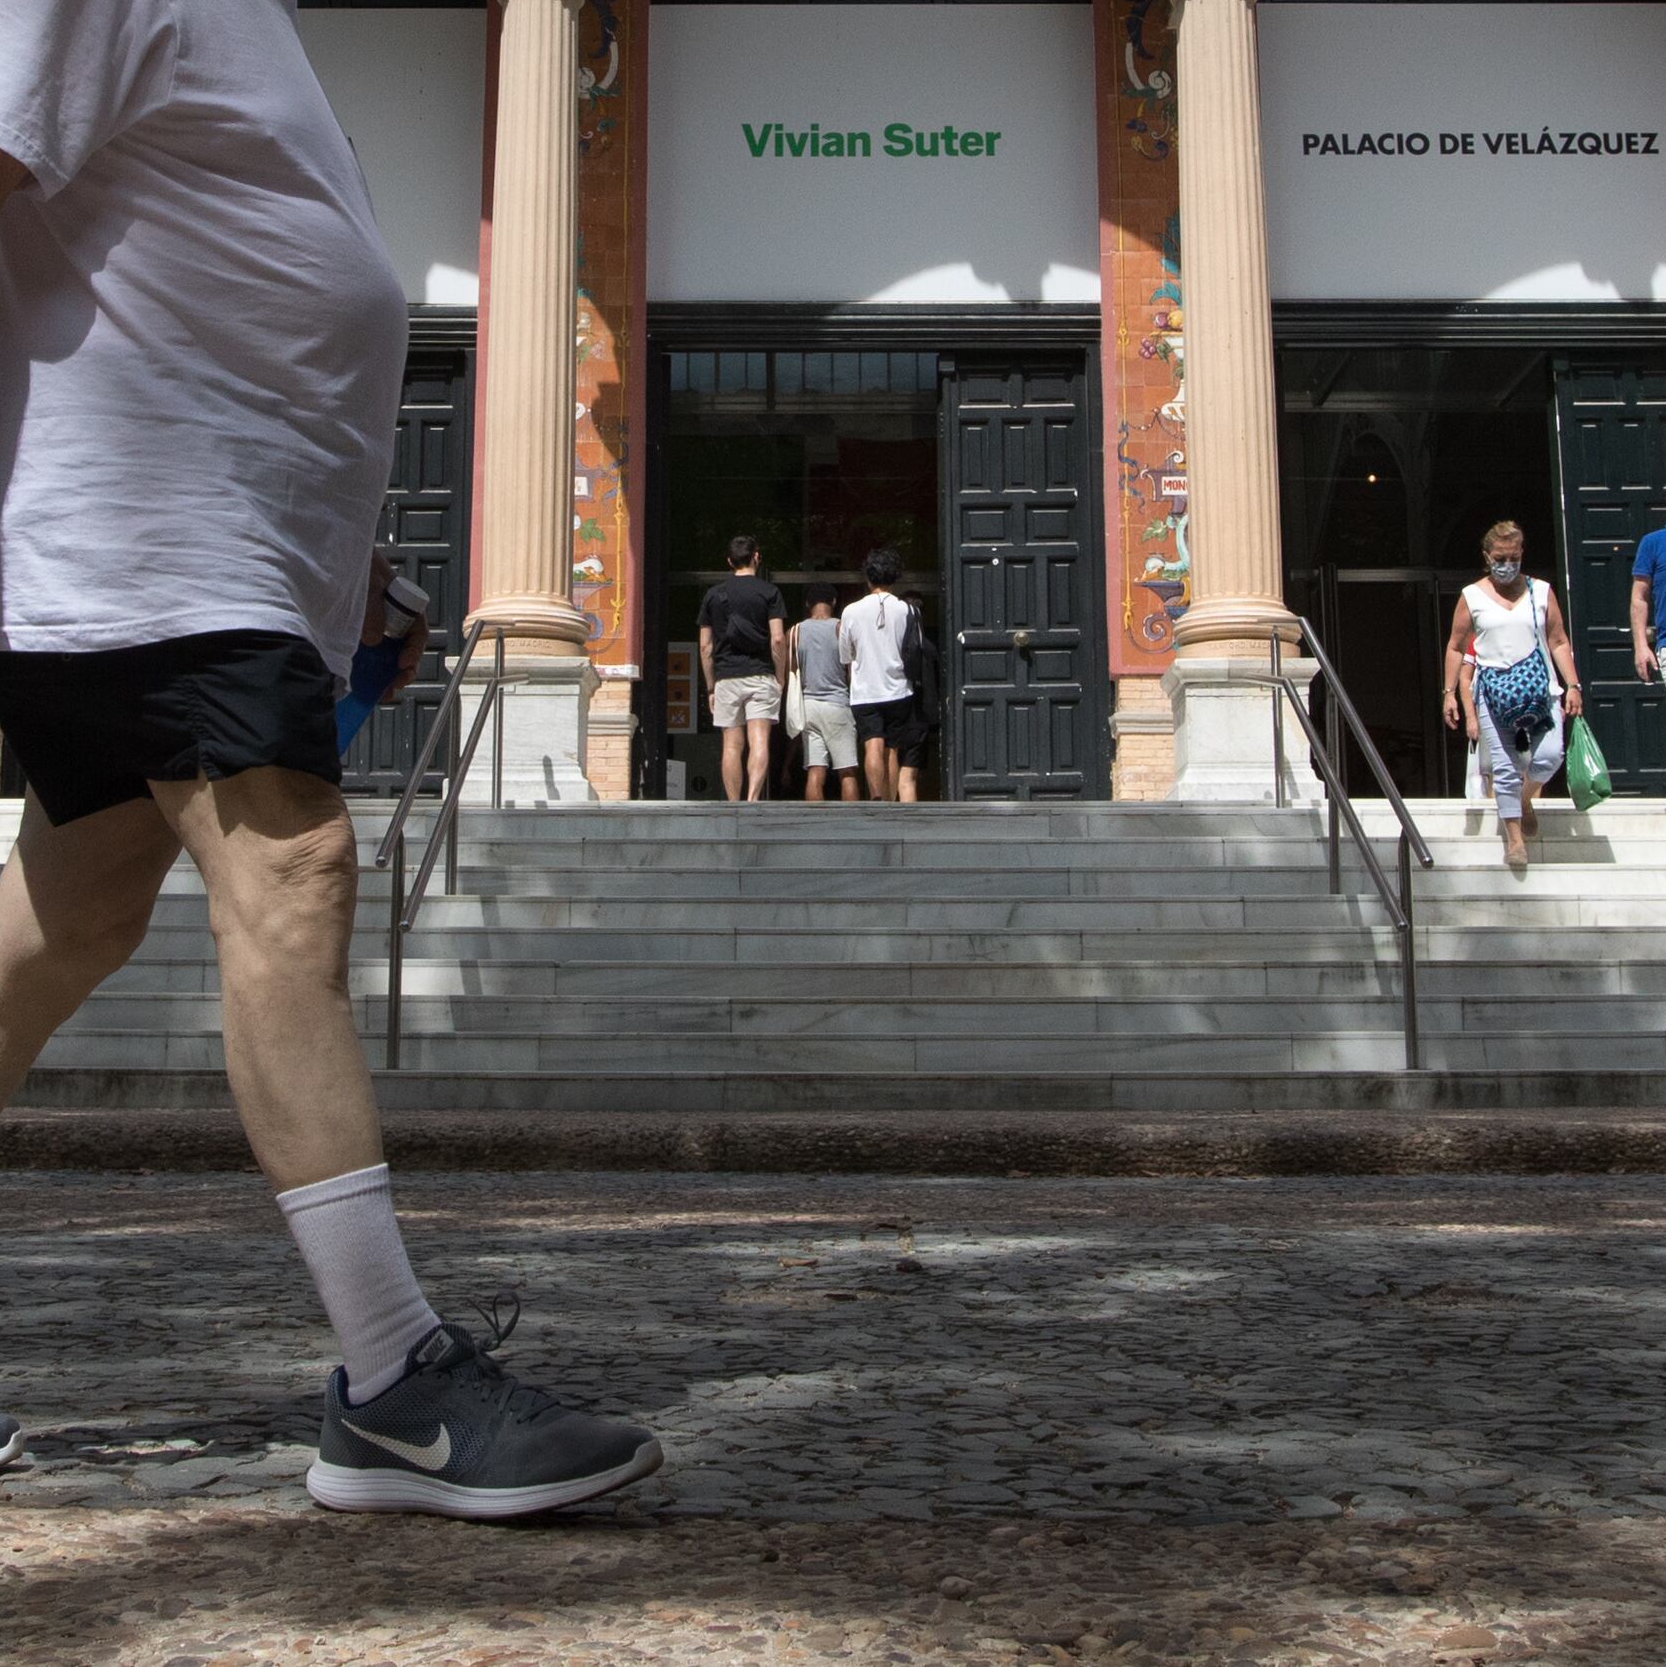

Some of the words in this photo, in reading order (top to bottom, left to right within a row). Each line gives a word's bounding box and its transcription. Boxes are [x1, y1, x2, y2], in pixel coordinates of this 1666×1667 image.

[741, 123, 871, 157] Vivian
[883, 123, 1001, 157] Suter
[1302, 132, 1430, 156] PALACIO
[1439, 132, 1475, 155] DE
[1483, 126, 1659, 156] VELÁZQUEZ
[1163, 480, 1187, 491] MON
